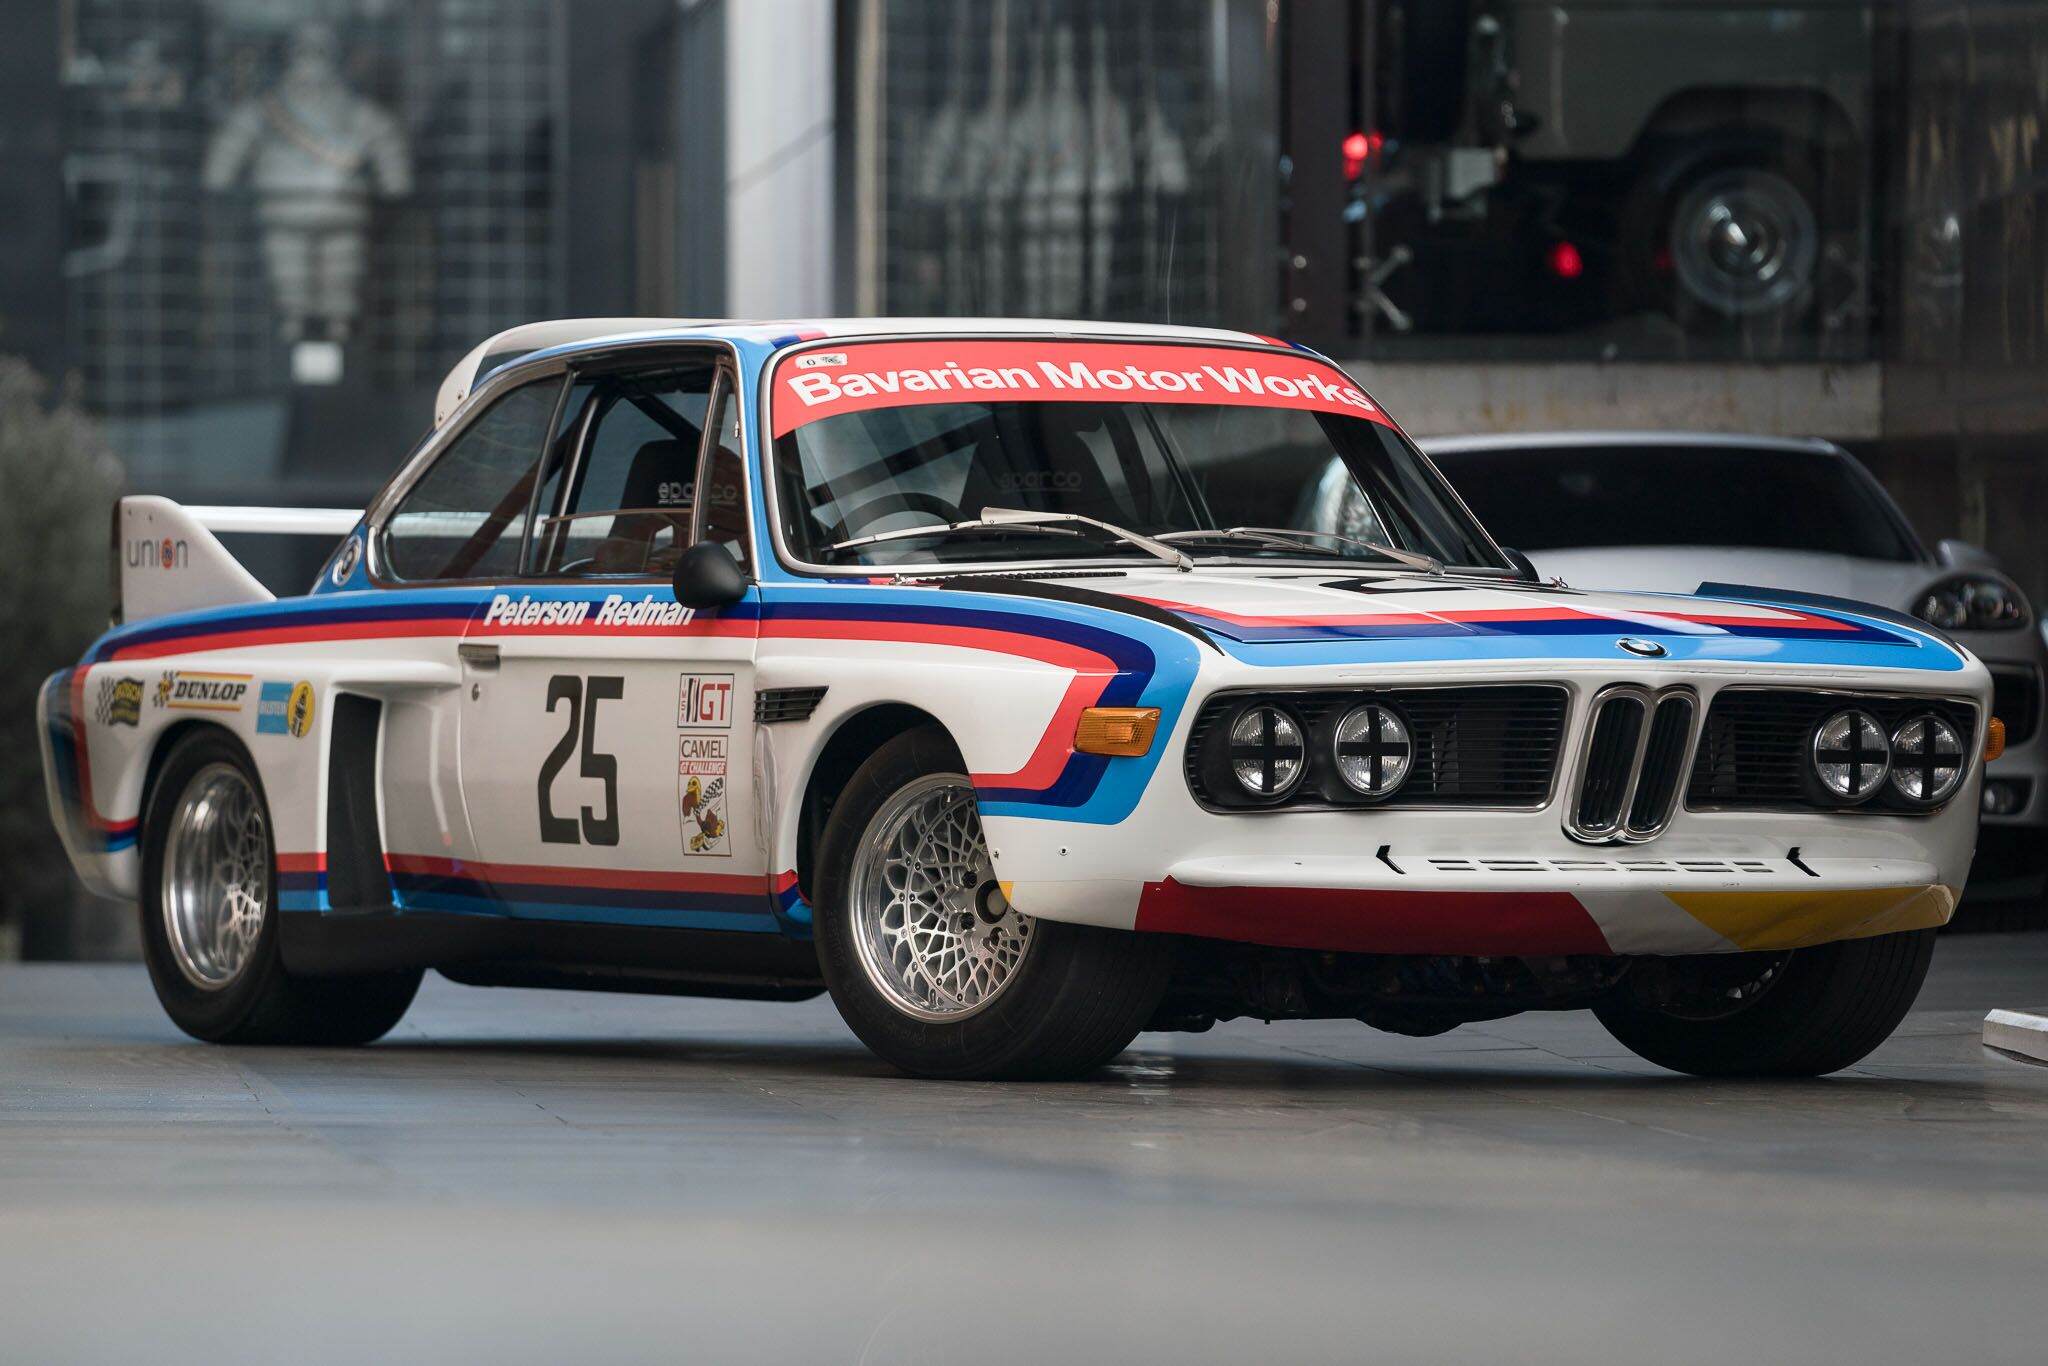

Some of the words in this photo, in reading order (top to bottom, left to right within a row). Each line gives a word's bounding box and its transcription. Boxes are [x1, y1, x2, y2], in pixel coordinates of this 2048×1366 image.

[787, 361, 1041, 407] Bavarian
[1036, 361, 1204, 394] Motor
[1200, 365, 1376, 412] Works
[127, 538, 189, 569] union
[483, 594, 590, 627] Peterson
[594, 594, 696, 627] Redman
[174, 681, 249, 701] DUNLOP
[700, 683, 731, 721] GT
[537, 674, 625, 847] 25
[681, 739, 726, 759] CAMEL
[680, 761, 690, 776] GT
[690, 761, 725, 777] CHALLENGE
